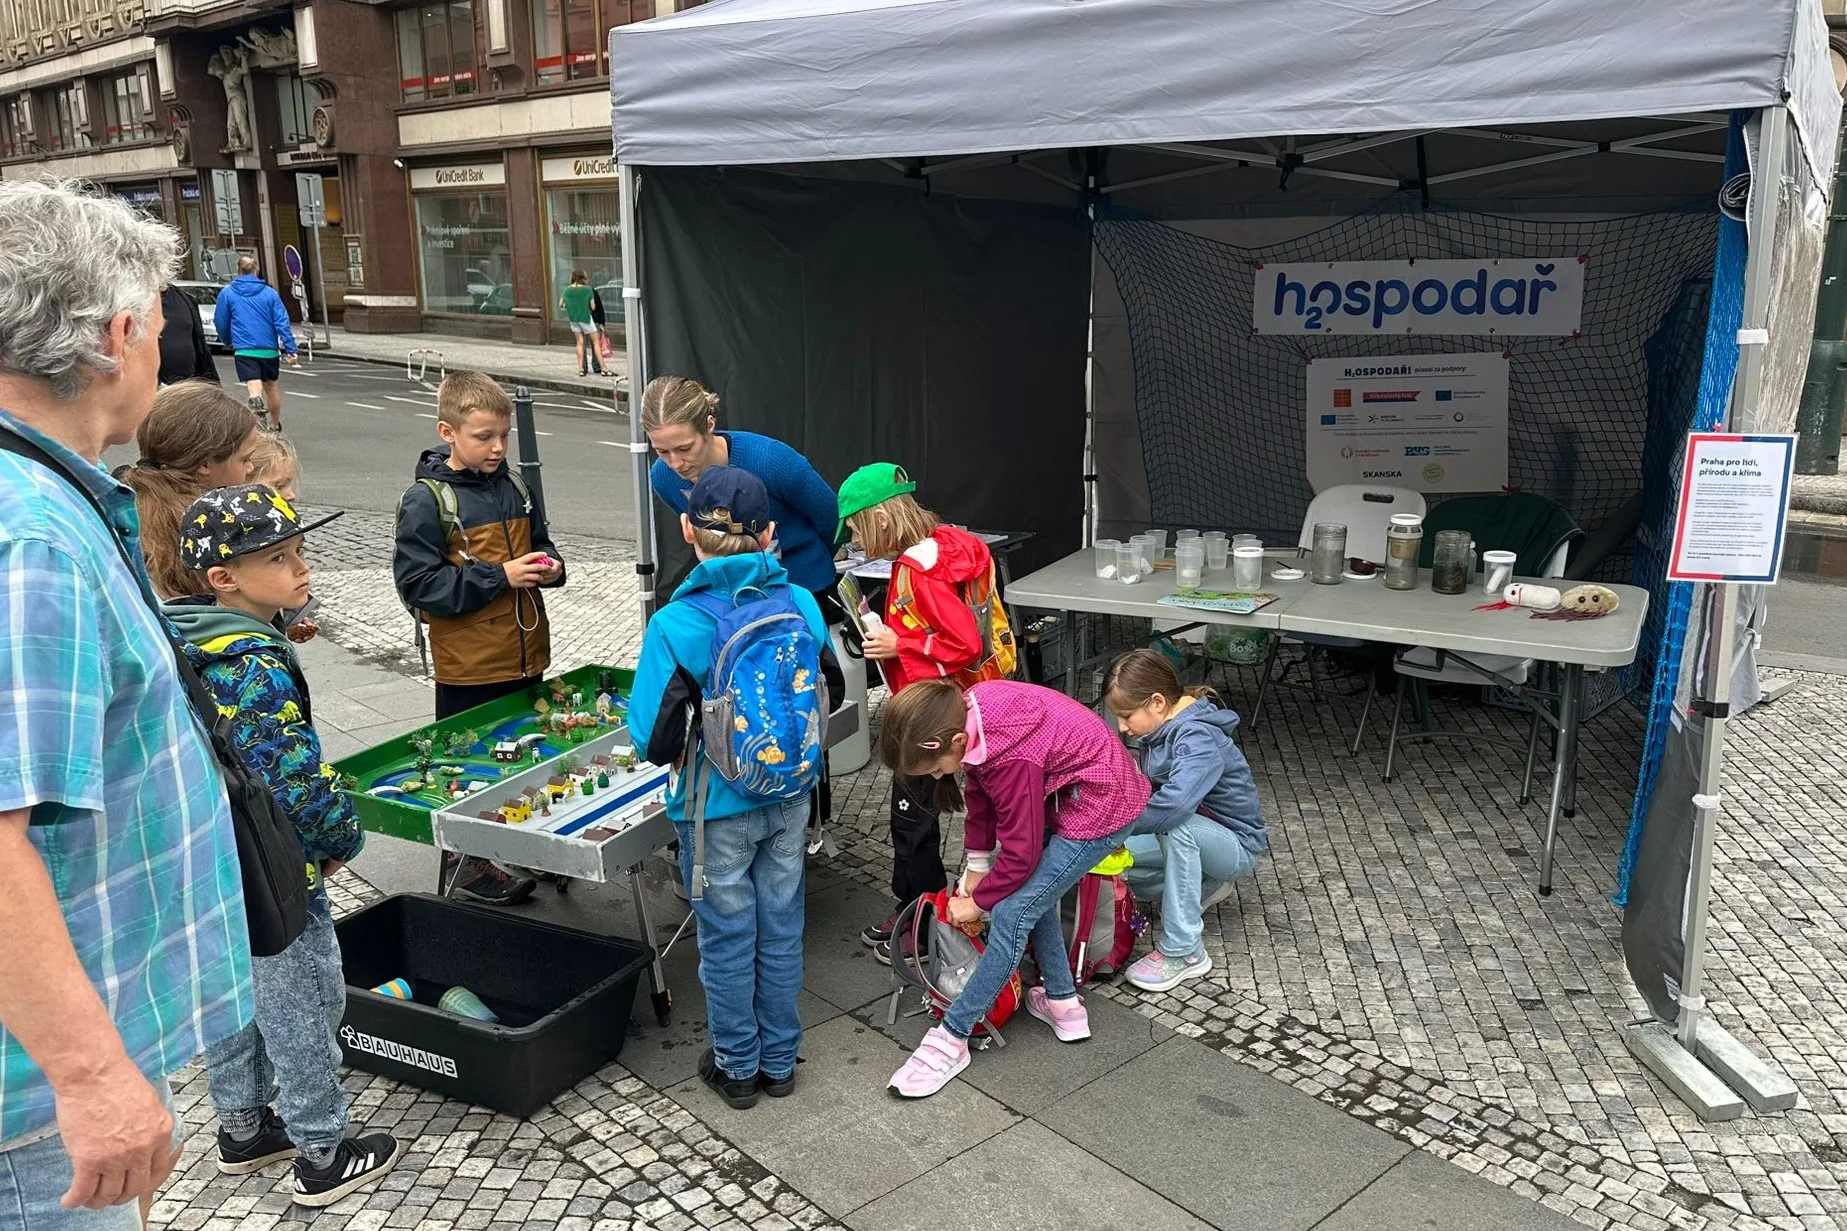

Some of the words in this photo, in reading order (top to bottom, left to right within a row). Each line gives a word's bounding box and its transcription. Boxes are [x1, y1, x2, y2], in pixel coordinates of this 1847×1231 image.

[582, 159, 616, 175] UniCredit
[442, 169, 468, 183] UniCredit
[468, 168, 485, 182] Bank
[1700, 458, 1725, 466] Praha
[1363, 470, 1403, 478] SKANSKA
[1699, 468, 1731, 477] přírodu
[1739, 469, 1762, 477] klima
[1229, 643, 1254, 654] 80%
[358, 1033, 457, 1077] BAUHAUS
